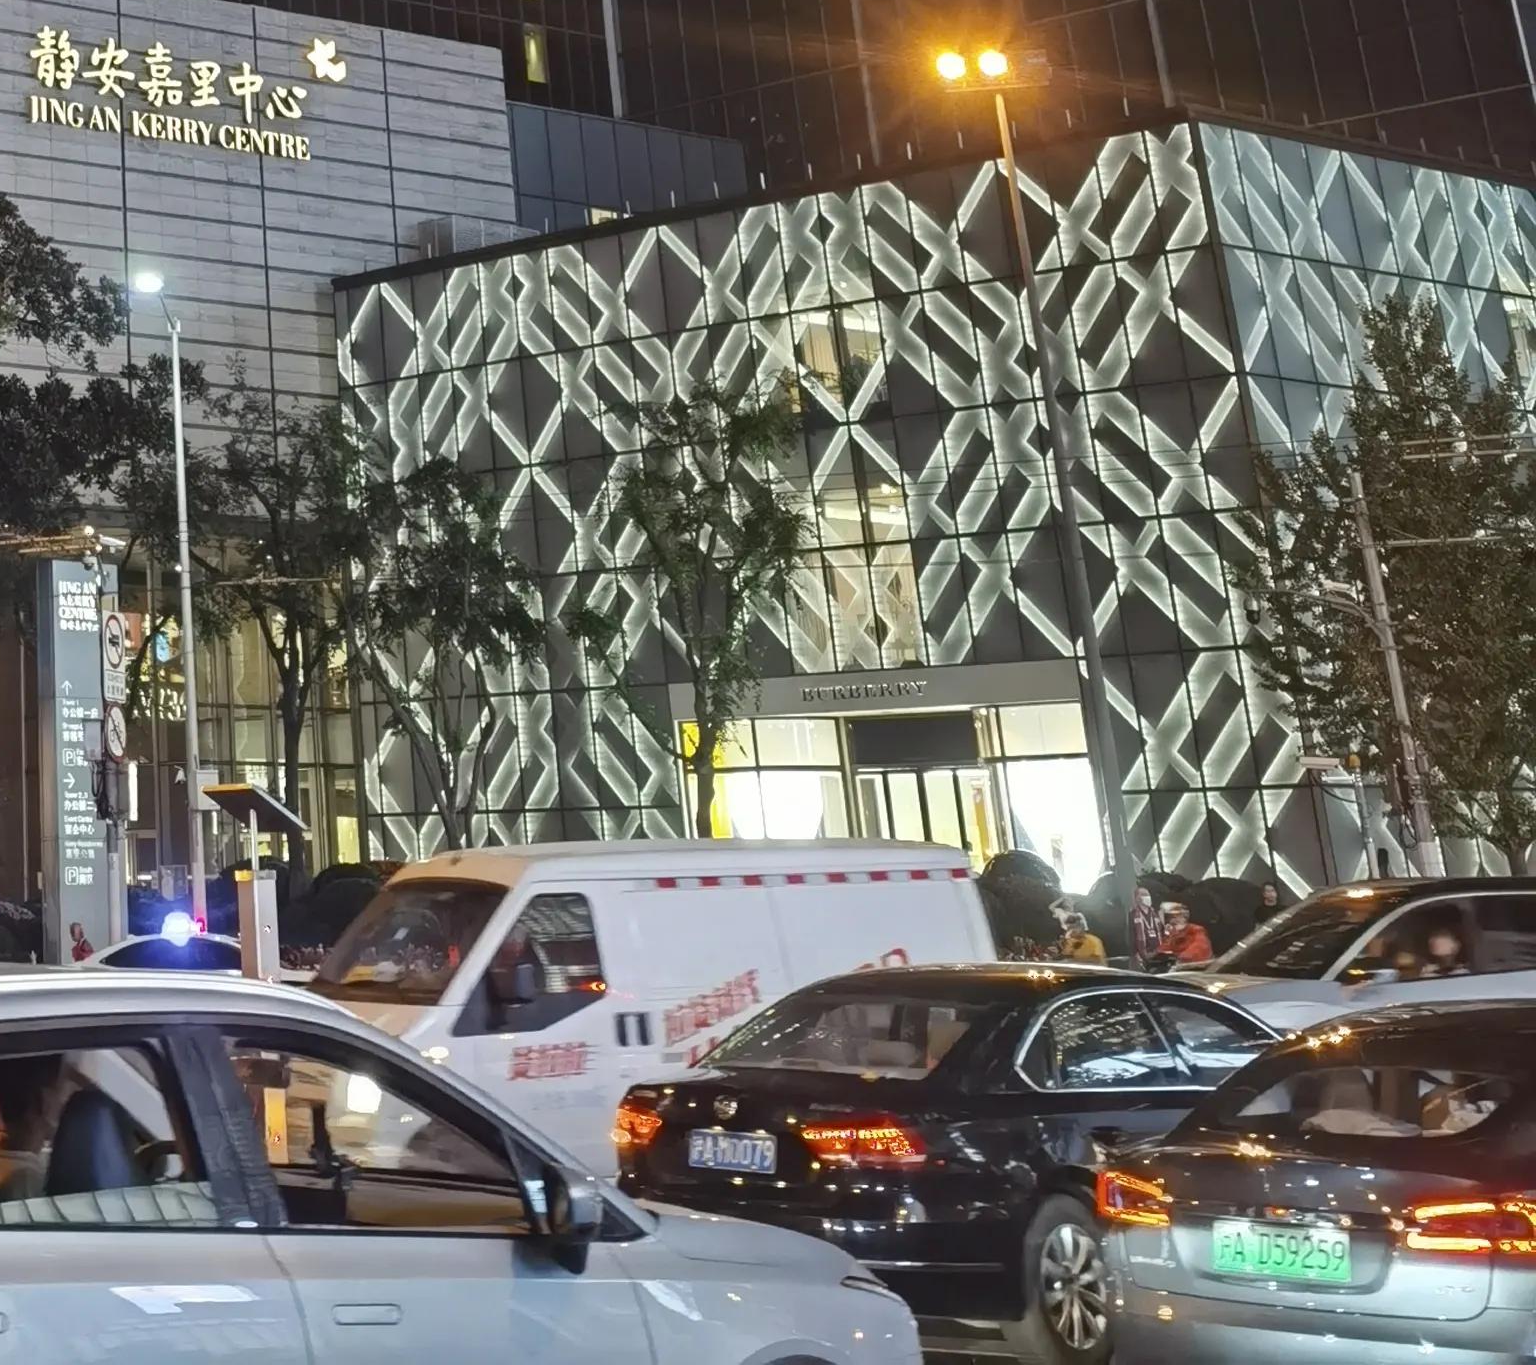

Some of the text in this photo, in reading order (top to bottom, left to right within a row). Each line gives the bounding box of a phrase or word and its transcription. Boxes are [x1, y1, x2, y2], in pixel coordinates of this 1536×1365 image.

[29, 25, 307, 124] 静安嘉里中心
[30, 94, 311, 161] JING AN KERRY CENTRE
[58, 607, 98, 621] CENTRE
[59, 594, 96, 608] KERRY
[802, 680, 928, 702] BURBERRY
[1258, 1232, 1345, 1271] D59259
